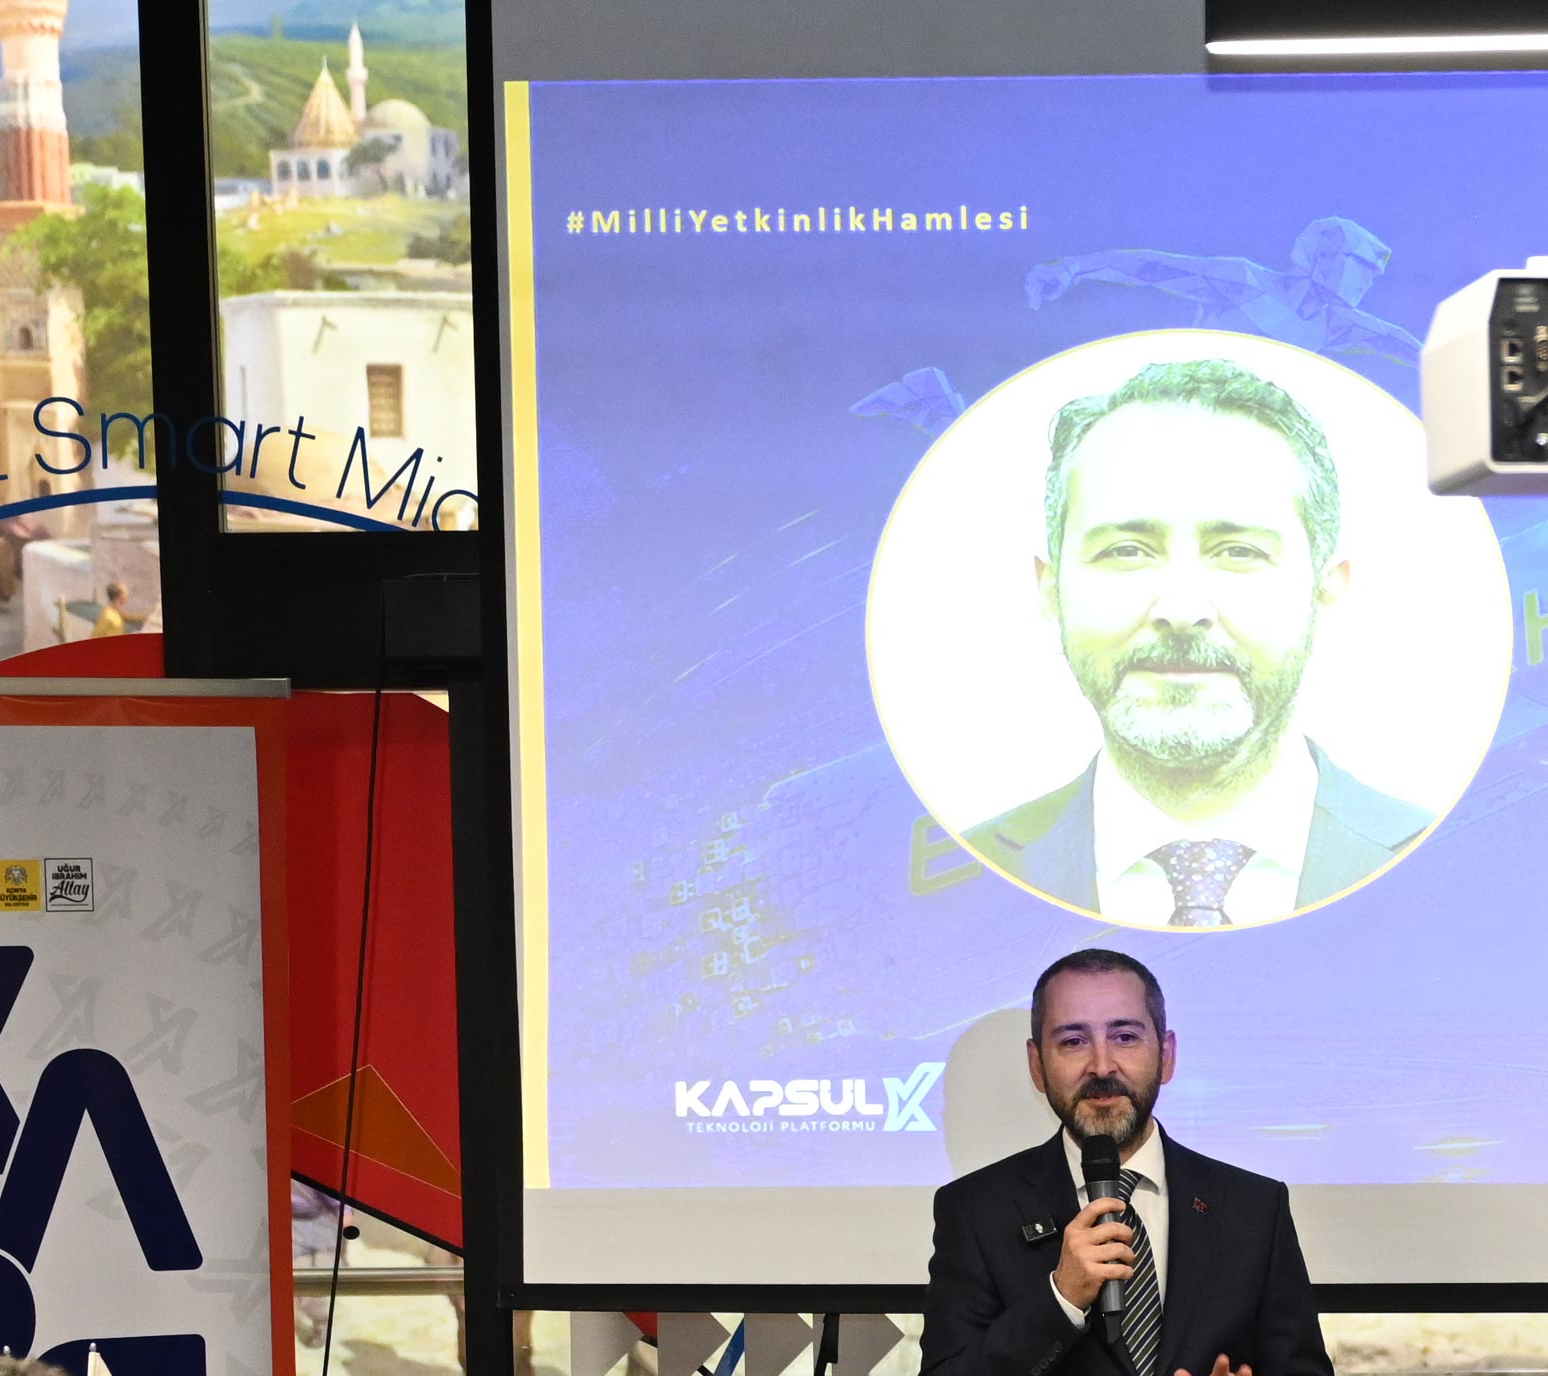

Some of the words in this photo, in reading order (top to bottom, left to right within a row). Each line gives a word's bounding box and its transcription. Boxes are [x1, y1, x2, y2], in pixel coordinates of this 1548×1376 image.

[566, 205, 1029, 233] #MilliYetkinlikHamlesi
[34, 398, 315, 489] Smart
[674, 1079, 885, 1118] KAPSUL
[780, 1121, 876, 1133] PLATFORMU
